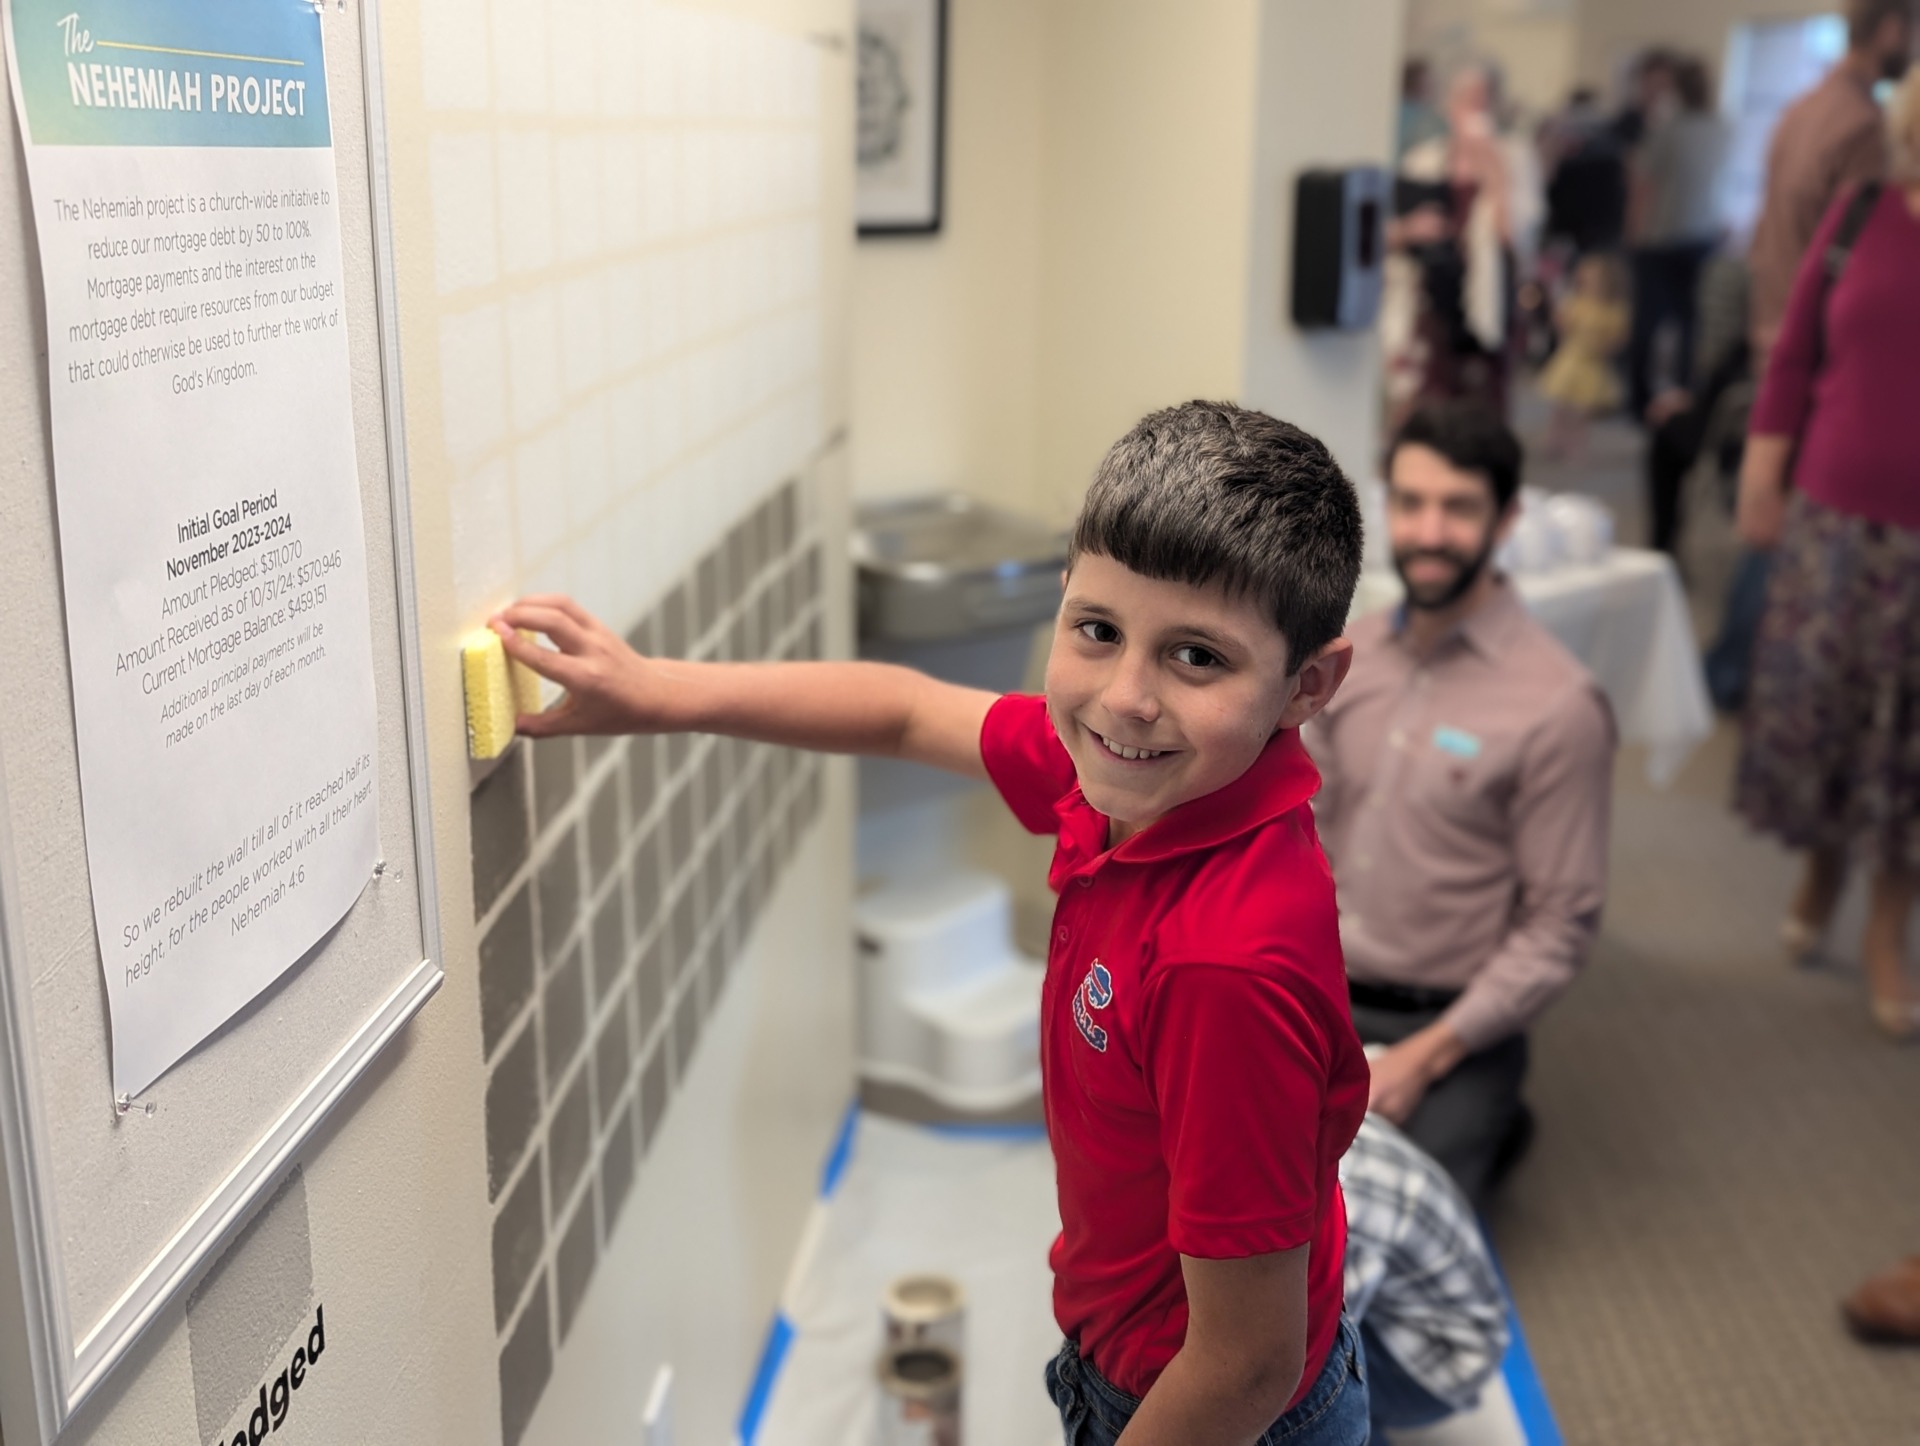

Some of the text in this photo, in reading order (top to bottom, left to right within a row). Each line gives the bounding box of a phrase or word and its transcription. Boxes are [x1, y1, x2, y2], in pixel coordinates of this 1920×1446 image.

[57, 13, 94, 56] The
[67, 62, 305, 116] NEHEMIAH PROJECT
[54, 189, 330, 221] The Nehemiah project is a church-wide initiative to
[88, 220, 312, 260] reduce our mortgage debt by 50 to 100%.
[69, 280, 335, 342] mortgage debt require resources from our budget
[87, 252, 316, 299] Mortgage payments and the interest on the
[68, 308, 339, 384] that could otherwise be used to further the work of
[172, 360, 258, 395] God's Kingdom.
[166, 512, 292, 580] November 2023-2024
[177, 489, 278, 544] Initial Goal Period
[116, 549, 342, 676] Amount Received as of 10/31/24: $570,946
[162, 539, 302, 619] Amount Pledged: $311,070
[142, 583, 328, 695] Current Mortgage Balance: $459,151
[160, 622, 324, 723] Additional principal payments will be
[165, 644, 327, 748] made on the last day of each month.
[123, 754, 370, 948] So we rebuilt the wall till all of it reached half its
[125, 780, 372, 988] height, for the people worked with all their heart.
[230, 864, 306, 937] Nehemiah 4:6
[219, 1303, 325, 1446] dged
